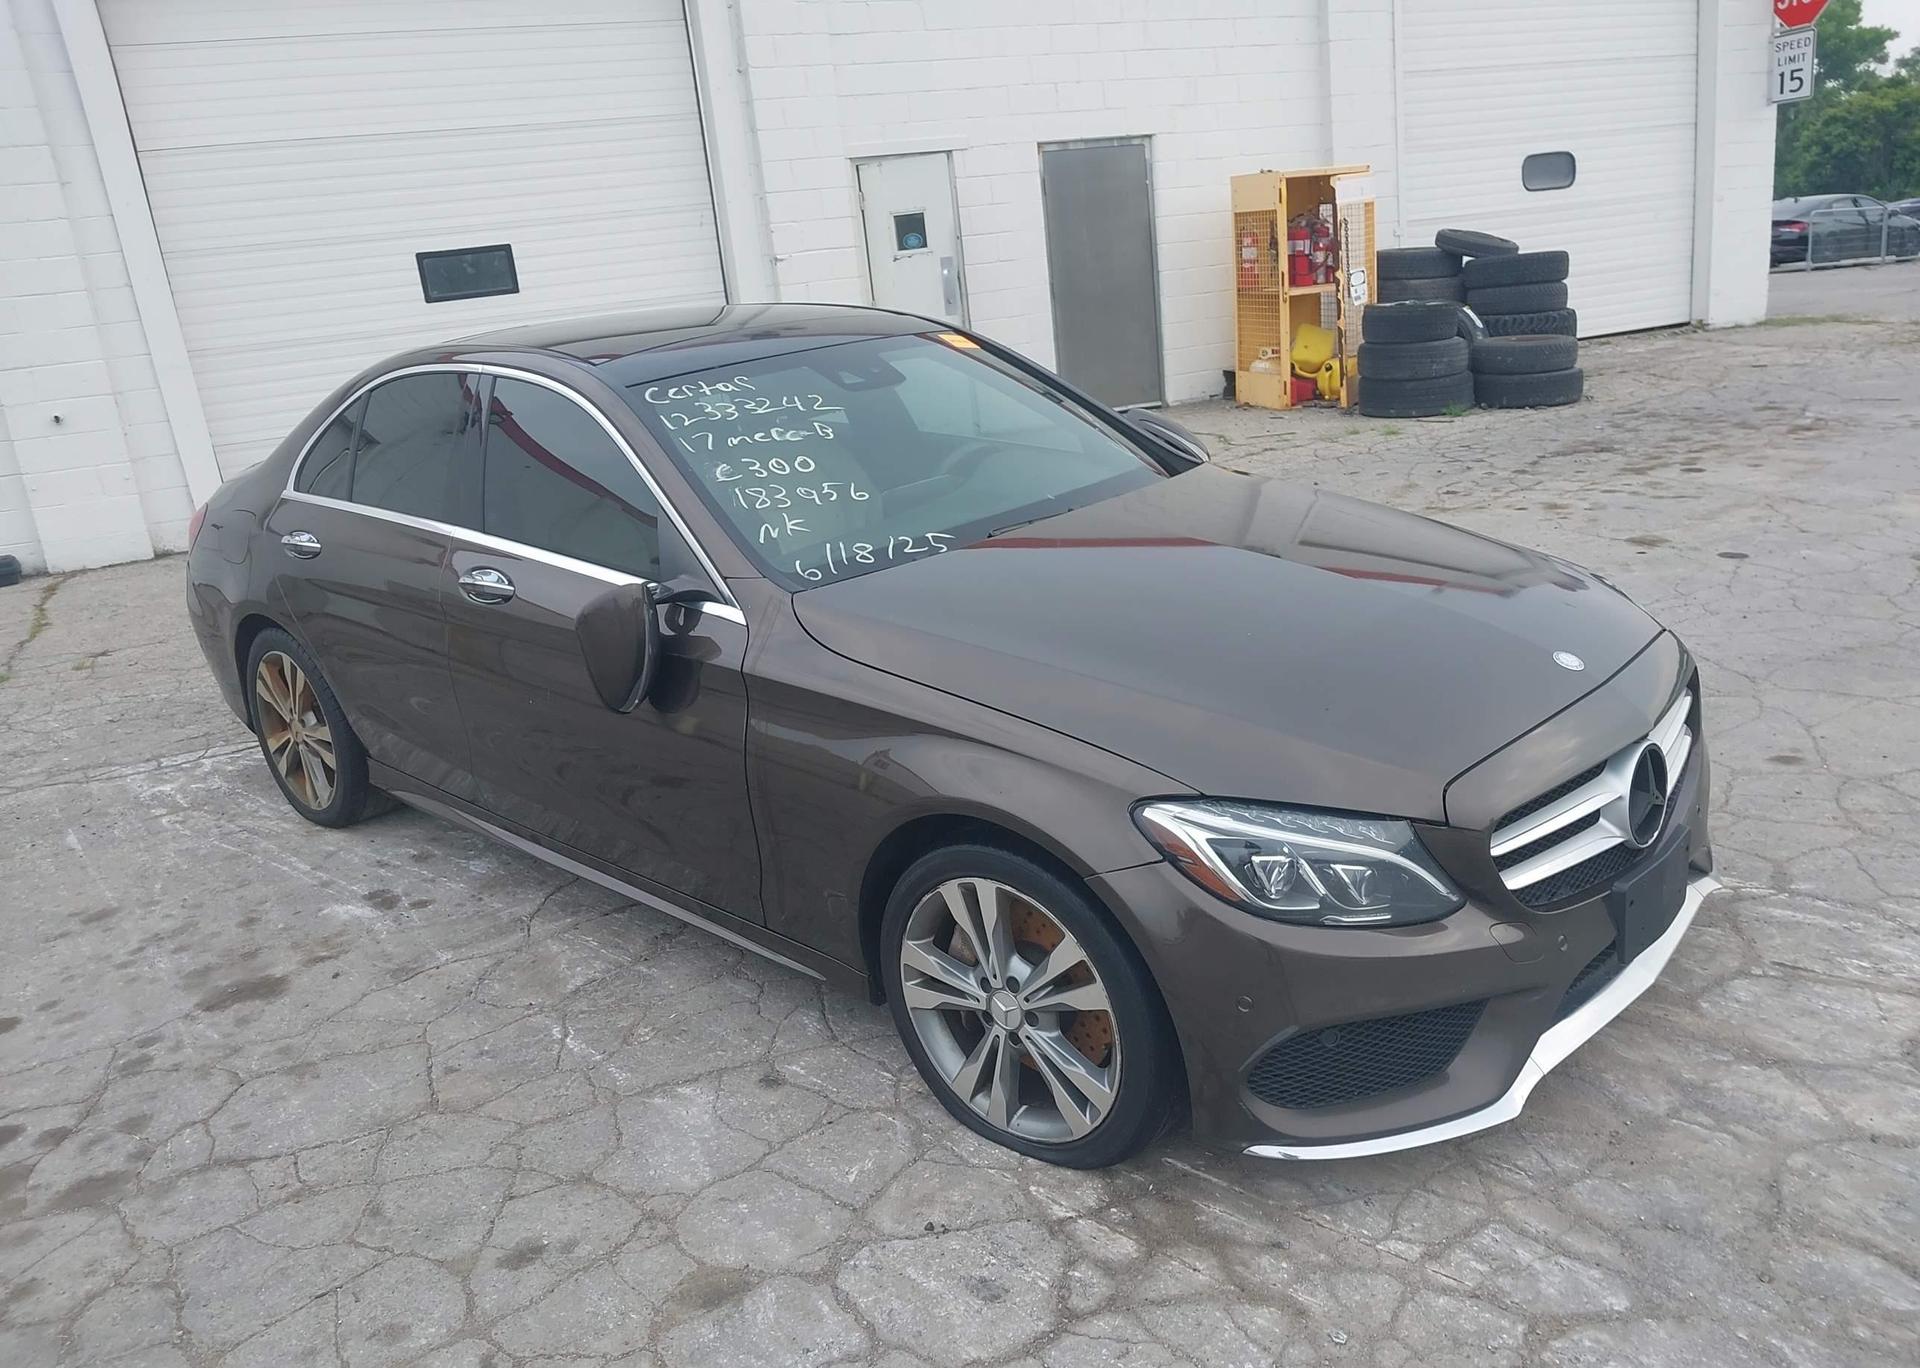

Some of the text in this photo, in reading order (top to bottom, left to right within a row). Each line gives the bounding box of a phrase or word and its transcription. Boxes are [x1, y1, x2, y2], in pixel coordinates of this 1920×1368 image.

[1775, 36, 1811, 53] SPEED
[1777, 52, 1807, 67] LIMIT
[1778, 68, 1804, 95] 15
[678, 432, 714, 454] 17
